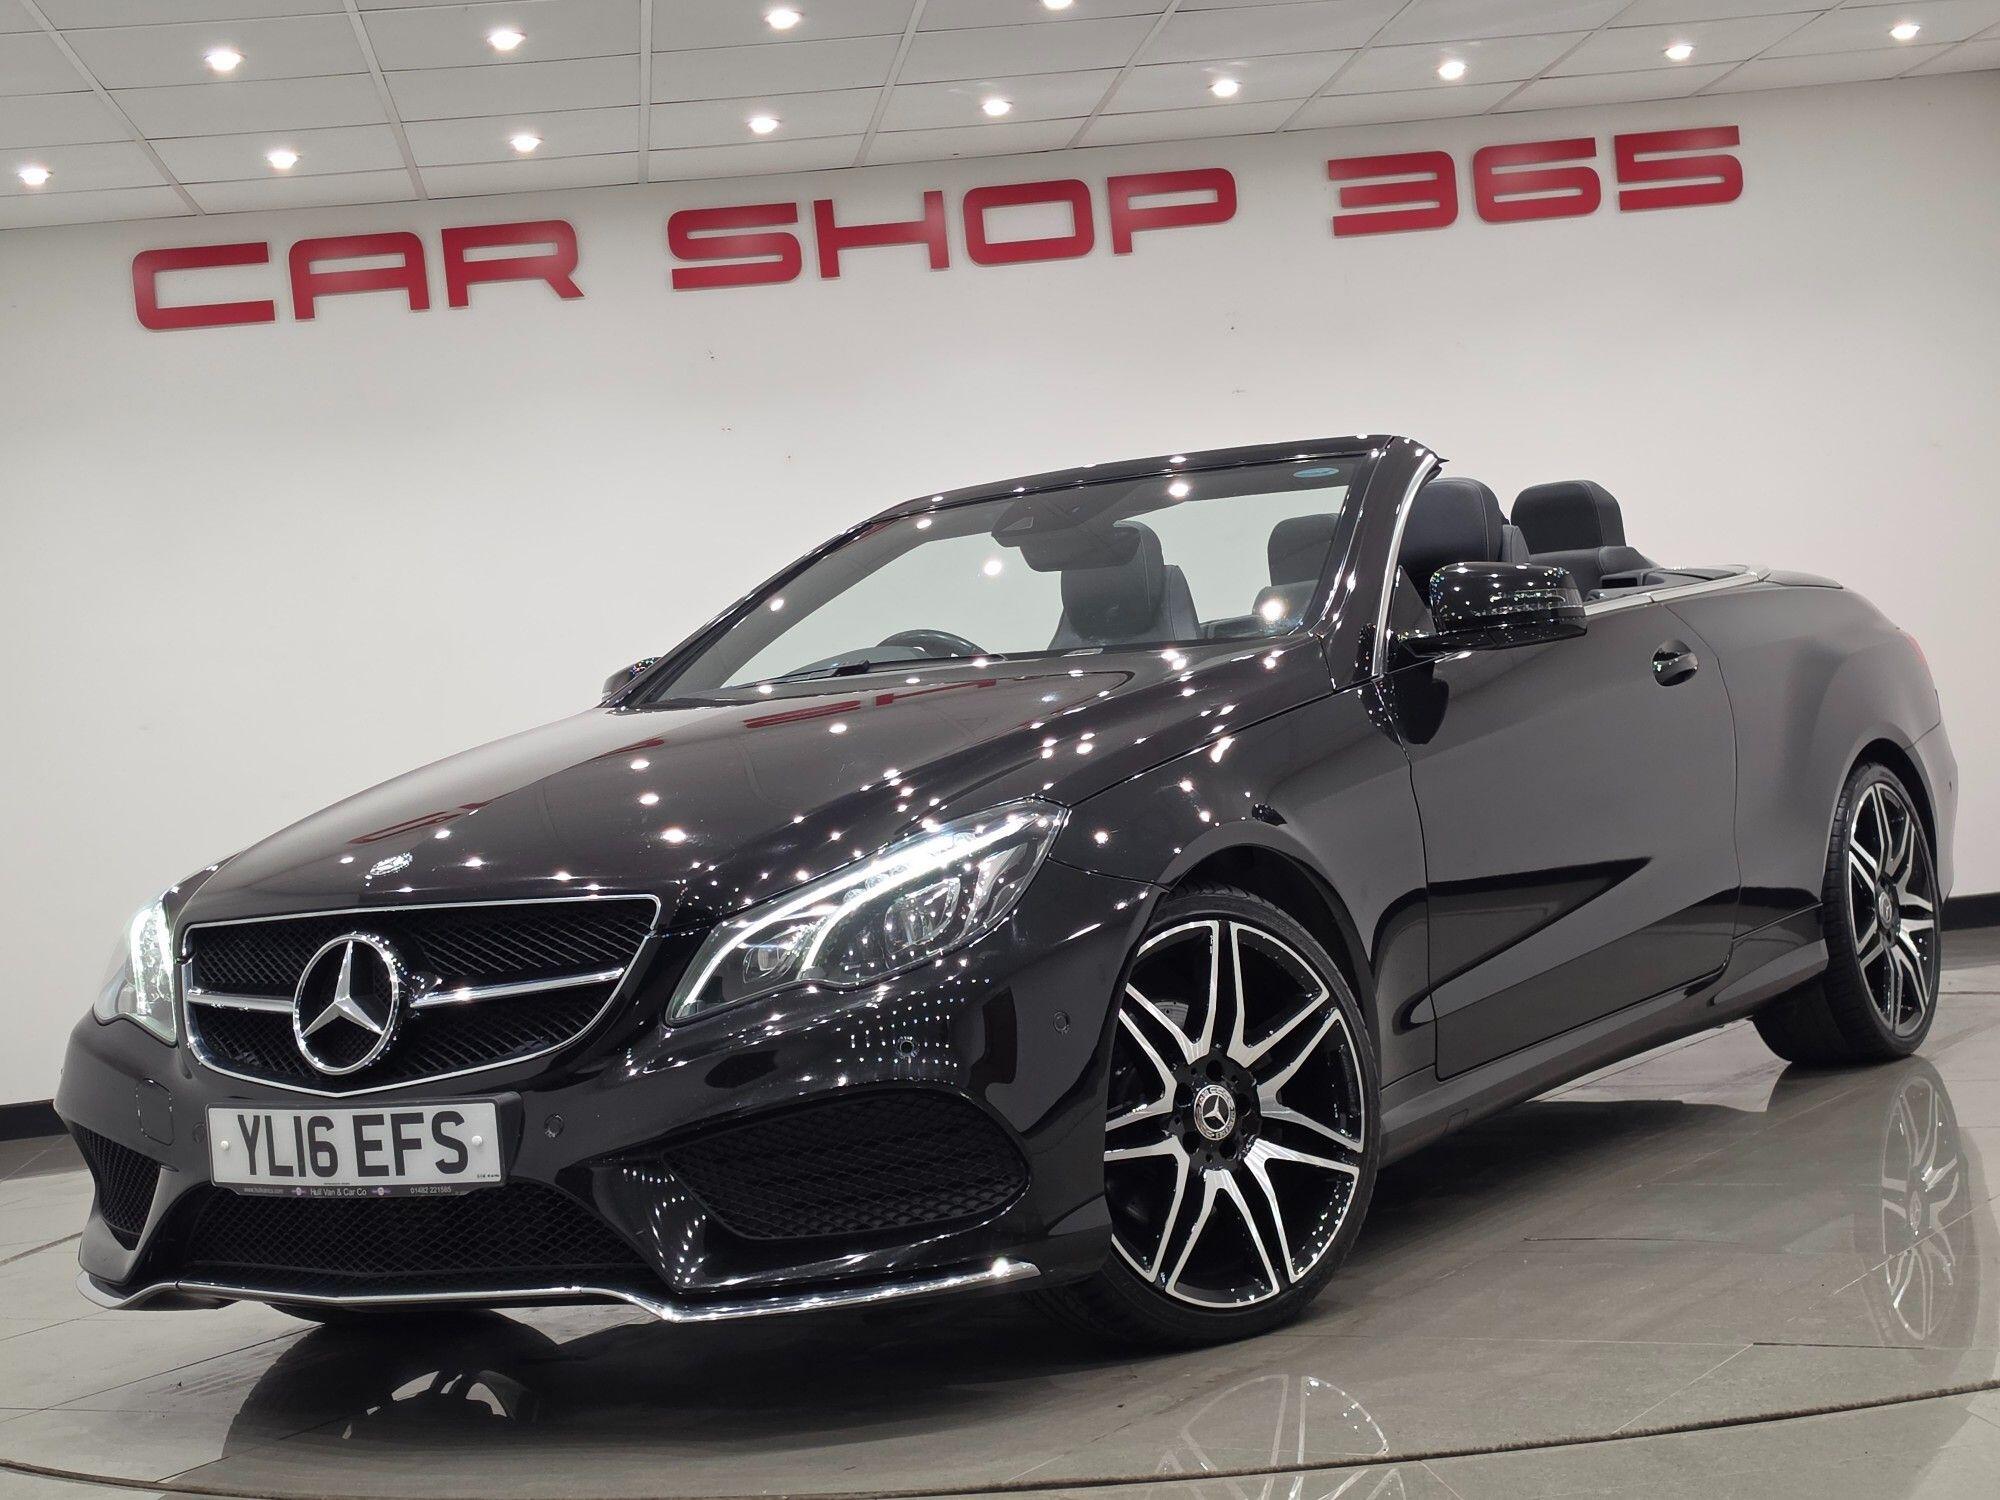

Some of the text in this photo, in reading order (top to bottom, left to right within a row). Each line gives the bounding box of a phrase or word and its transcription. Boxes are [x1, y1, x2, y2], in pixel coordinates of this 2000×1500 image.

[132, 125, 1743, 330] CAR SHOP 365
[237, 1110, 469, 1178] YL16 EFS
[323, 1188, 336, 1196] Van
[343, 1187, 356, 1196] Car
[356, 1187, 367, 1196] Co
